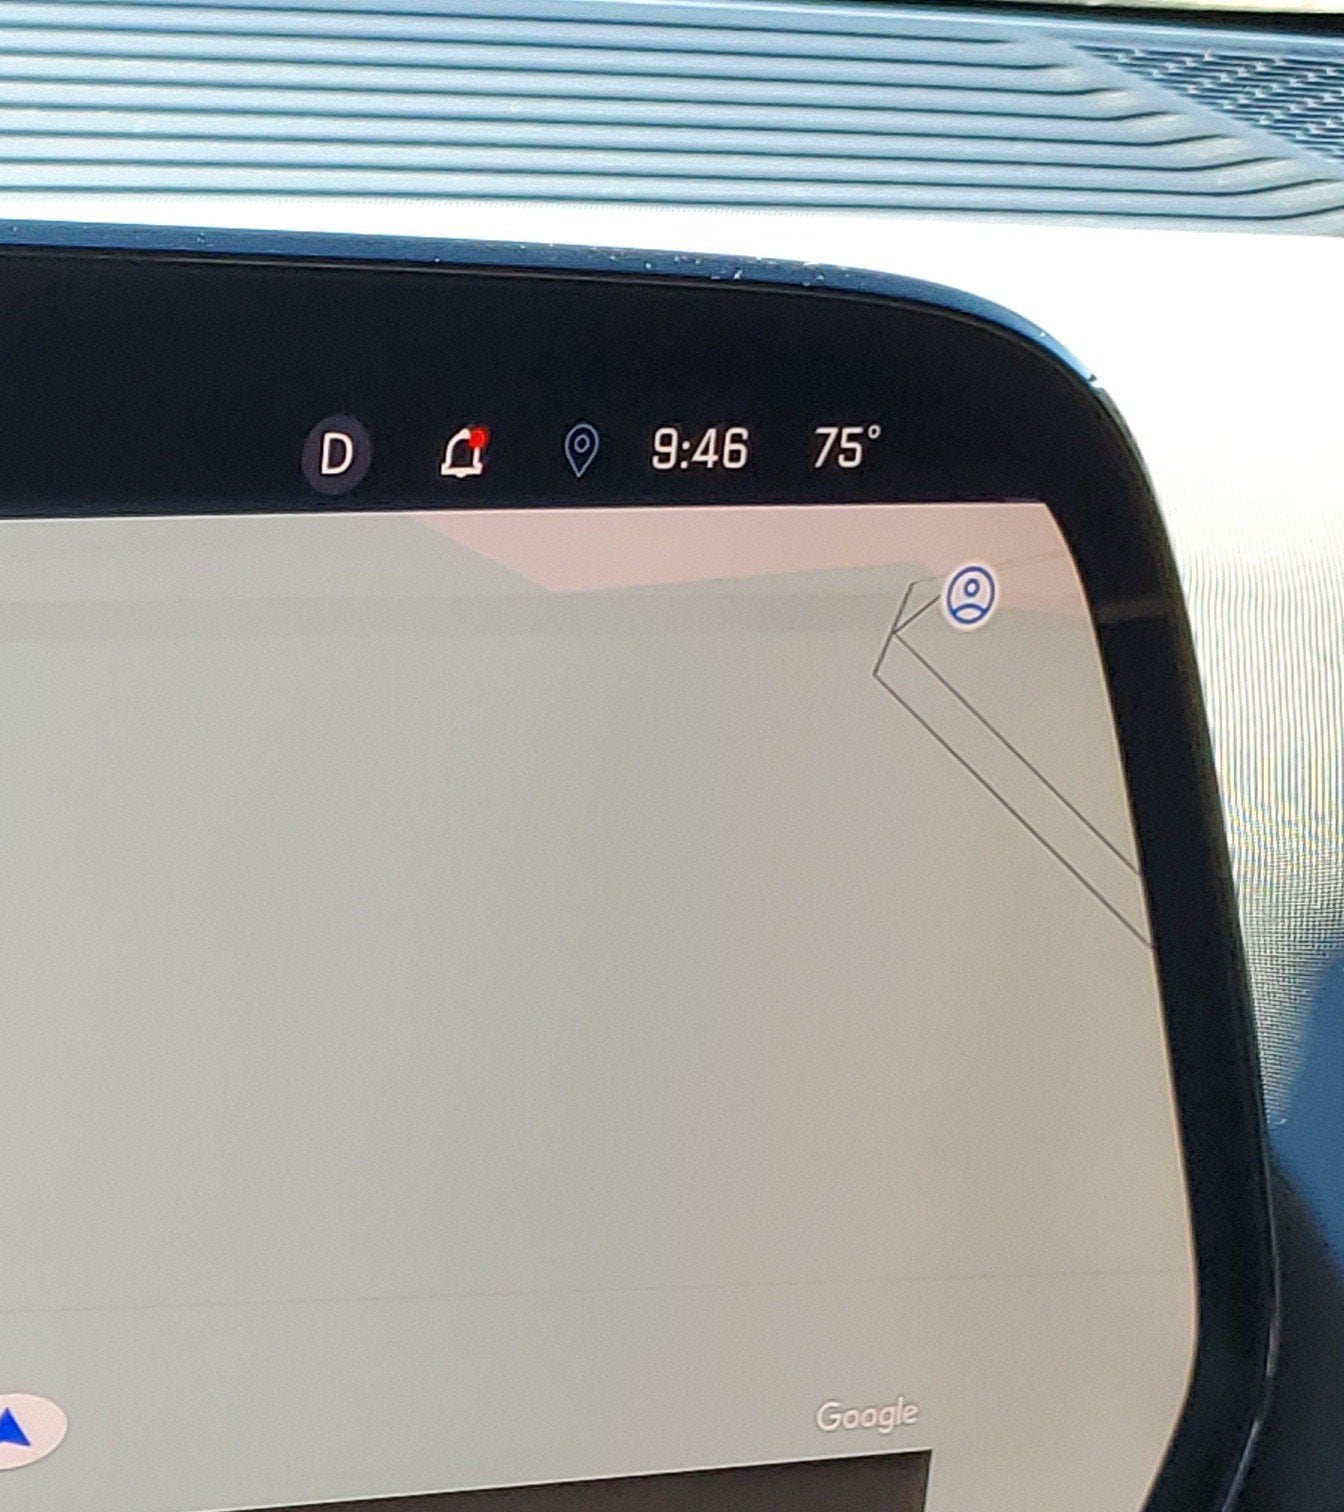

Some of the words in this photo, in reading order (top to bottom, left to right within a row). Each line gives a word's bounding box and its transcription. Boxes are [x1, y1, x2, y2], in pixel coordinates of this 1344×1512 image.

[320, 432, 354, 475] D
[651, 426, 749, 470] 9:46
[814, 424, 882, 468] 75°
[816, 1396, 919, 1434] Google
